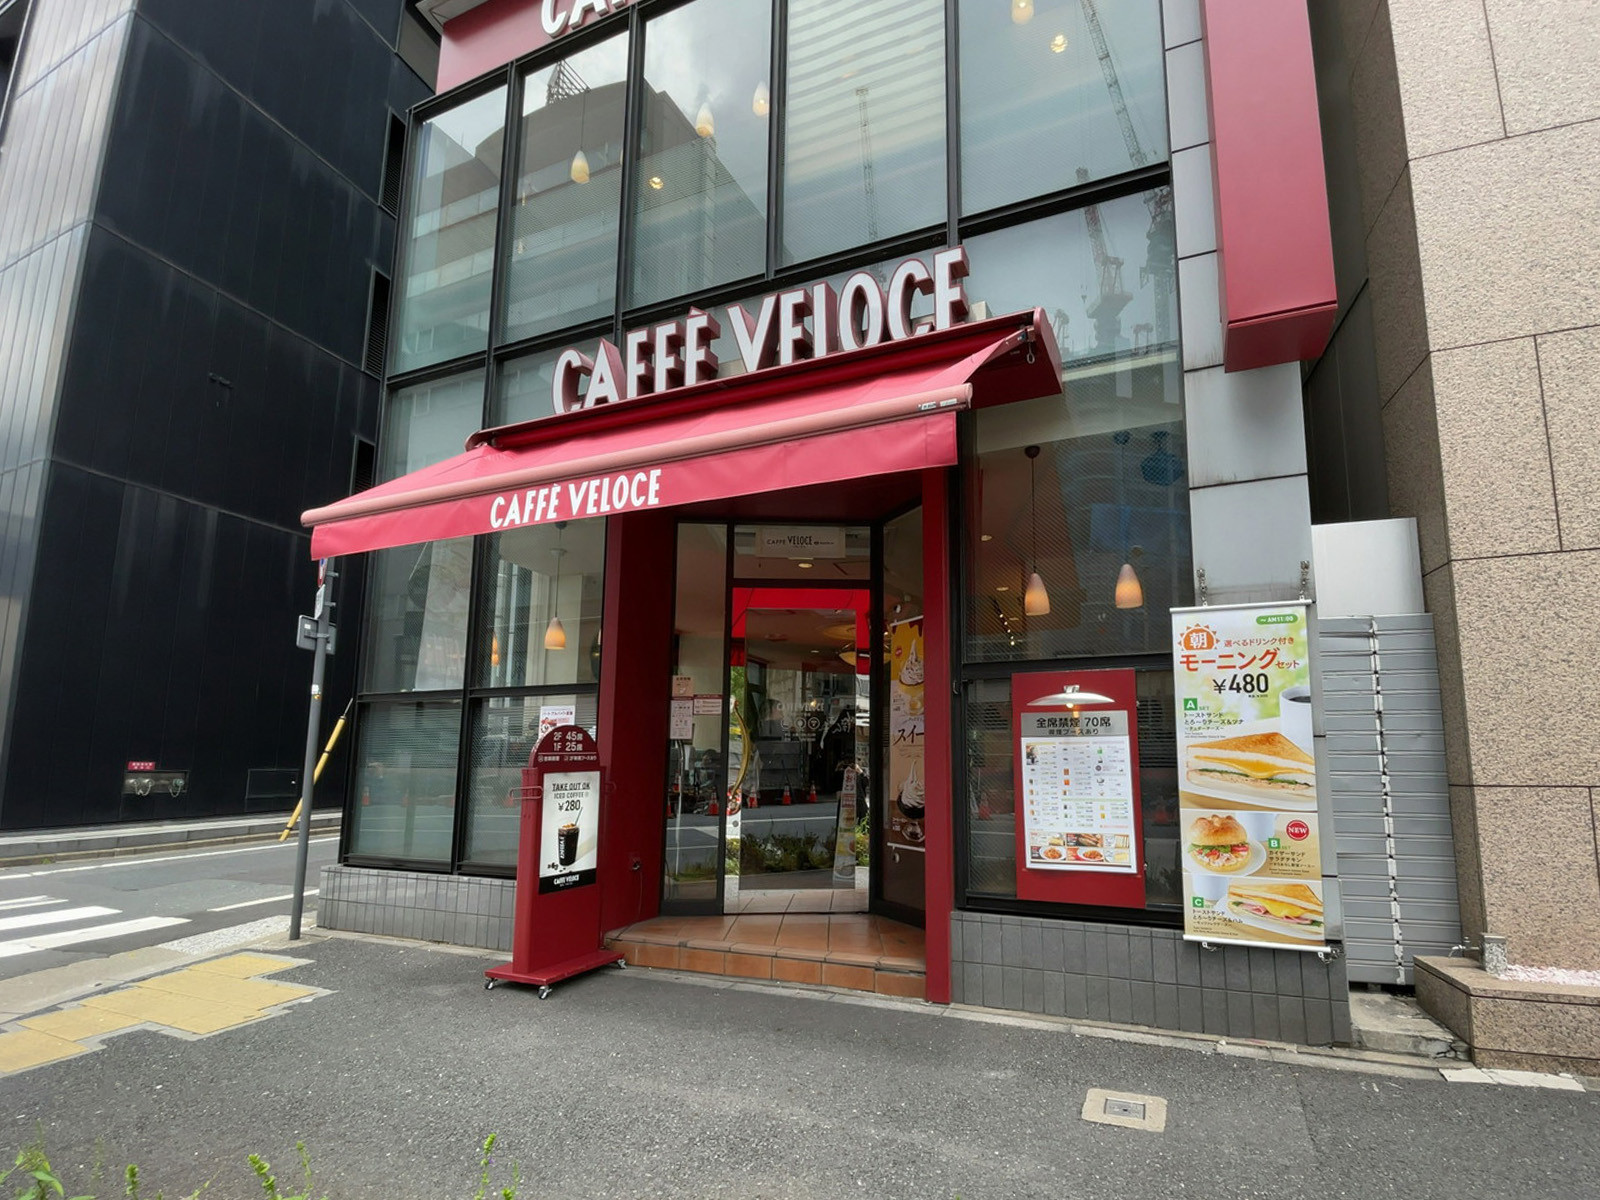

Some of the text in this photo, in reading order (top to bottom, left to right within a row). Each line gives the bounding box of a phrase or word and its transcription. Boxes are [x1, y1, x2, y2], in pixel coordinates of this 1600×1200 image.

[727, 245, 970, 373] VELOCE
[490, 469, 662, 529] CAFFÈ VELOCE
[787, 535, 813, 546] VELOCE
[1189, 632, 1208, 649] 朝
[1223, 637, 1295, 648] 選べるドリンク付き
[1212, 673, 1269, 695] ¥480
[1186, 700, 1196, 709] A
[1036, 716, 1111, 729] 全席禁煙 70席
[553, 731, 563, 741] 2F
[553, 742, 562, 751] 1F
[552, 782, 591, 792] TAKE OUT OK
[557, 800, 581, 812] ¥280
[1287, 826, 1308, 835] NEW
[1270, 839, 1279, 848] B
[1194, 898, 1203, 907] C
